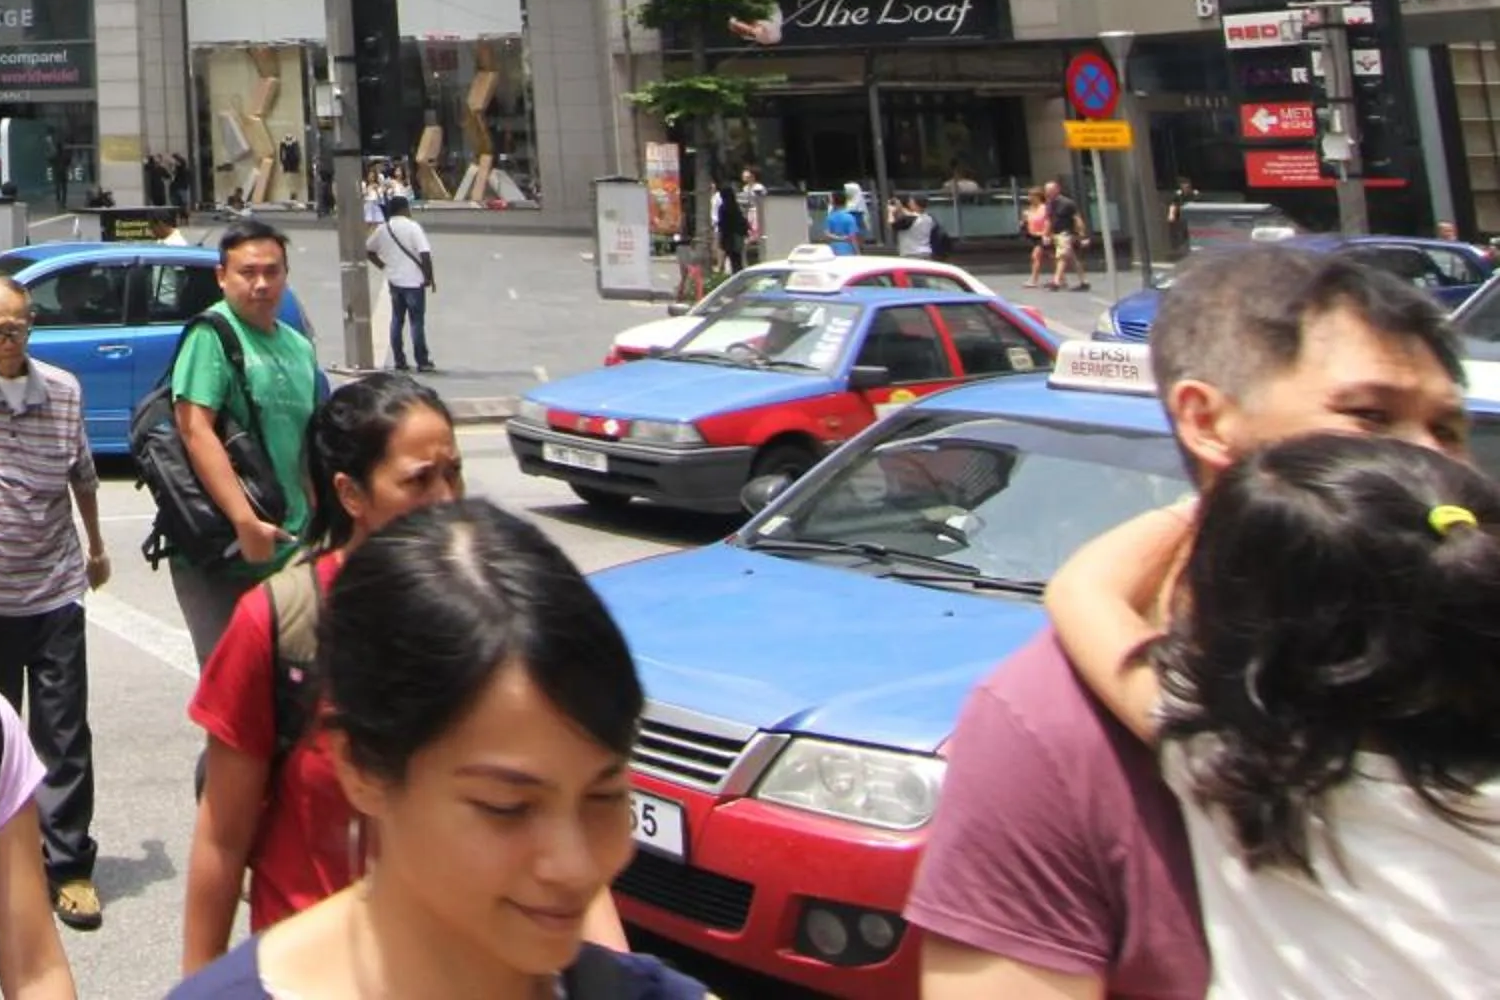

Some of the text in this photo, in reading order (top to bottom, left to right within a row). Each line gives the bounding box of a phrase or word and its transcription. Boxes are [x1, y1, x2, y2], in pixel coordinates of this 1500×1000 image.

[1227, 23, 1278, 41] RED
[0, 50, 68, 66] compare!
[1079, 346, 1132, 363] TEKSI
[1071, 360, 1140, 381] BERMETER
